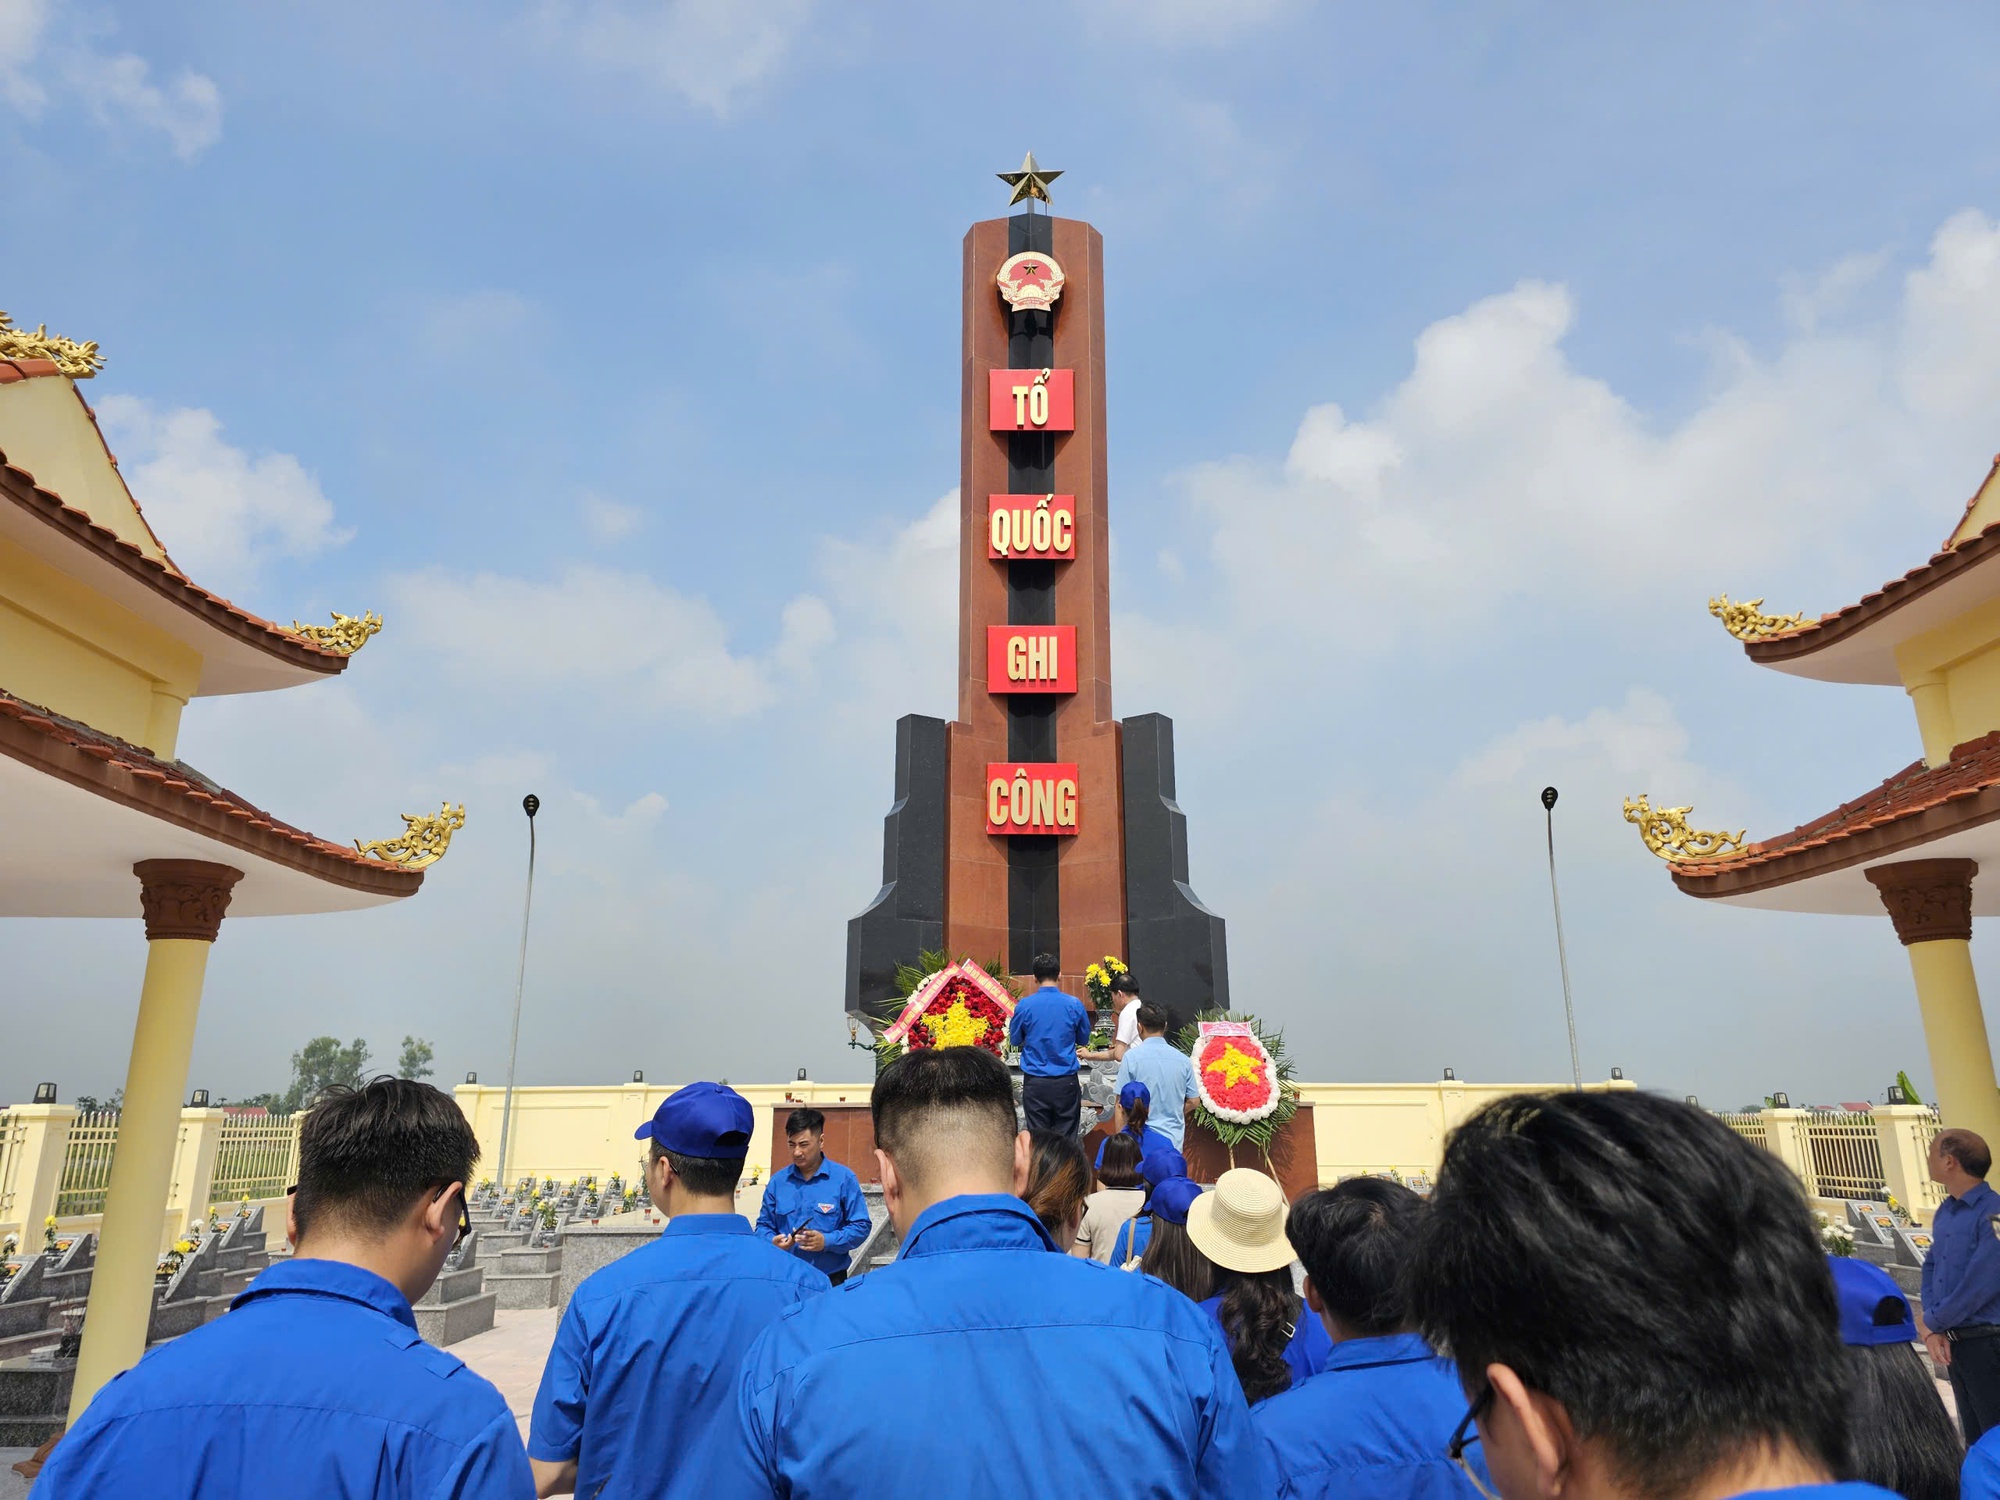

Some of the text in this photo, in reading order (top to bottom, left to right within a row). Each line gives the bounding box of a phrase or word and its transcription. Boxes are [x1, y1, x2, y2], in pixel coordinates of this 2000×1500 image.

[1012, 368, 1050, 425] TỔ
[992, 494, 1072, 555] QUỐC
[1008, 636, 1058, 680] GHI
[990, 768, 1076, 826] CÔNG
